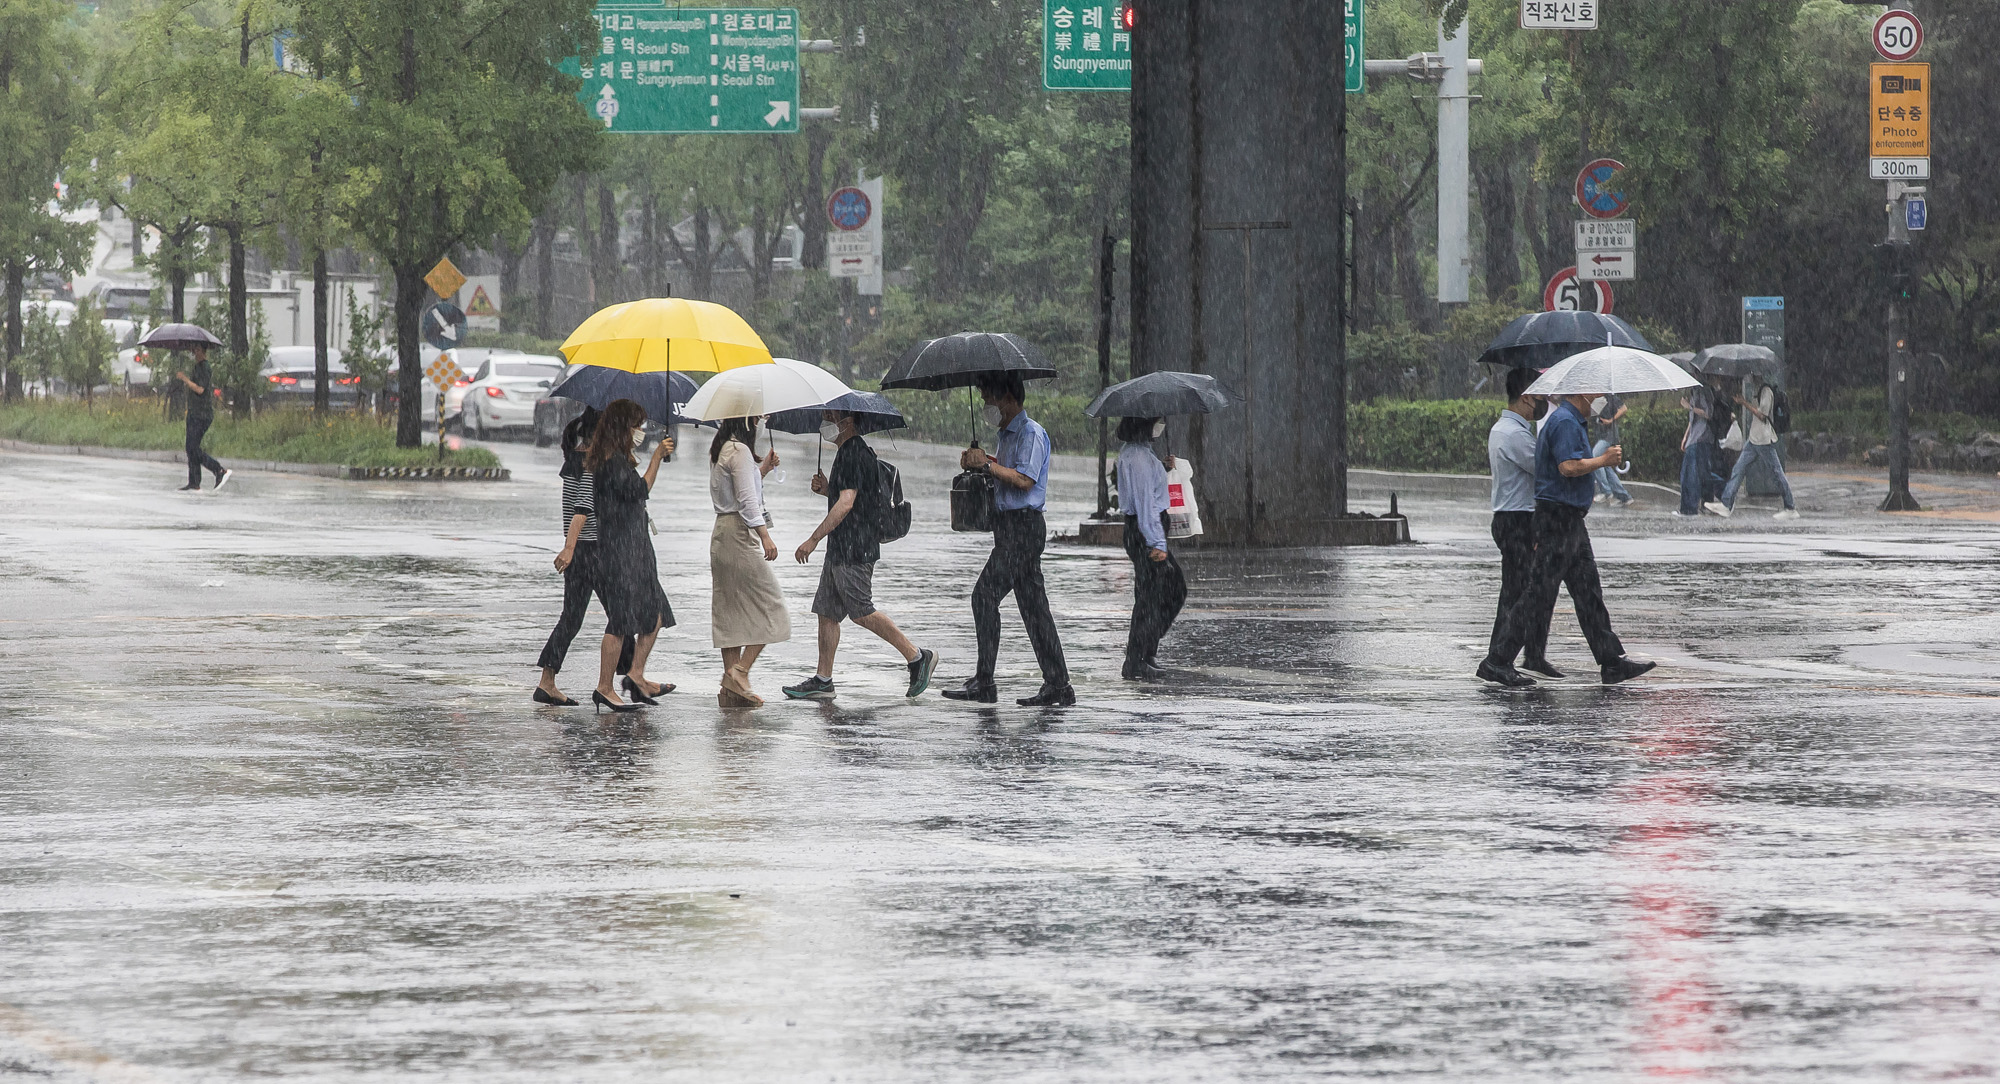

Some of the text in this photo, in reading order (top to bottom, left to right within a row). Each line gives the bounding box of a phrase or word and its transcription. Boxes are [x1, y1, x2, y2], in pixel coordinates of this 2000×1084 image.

[1525, 1, 1594, 22] 직좌신호
[721, 13, 793, 32] 원효대교
[1055, 32, 1130, 52] 崇禮門
[1883, 26, 1913, 48] 50
[602, 36, 635, 55] 울역
[636, 42, 690, 55] Seoul Stn
[1053, 54, 1132, 74] Sungnyemun
[636, 73, 707, 88] Sungnyemun
[721, 73, 775, 86] Seoul Stn
[600, 102, 615, 114] 21
[1878, 106, 1922, 121] 단속중
[1882, 126, 1918, 137] Photo
[1875, 139, 1925, 149] enforcement
[1881, 161, 1918, 176] 300m
[1592, 268, 1621, 277] 120m
